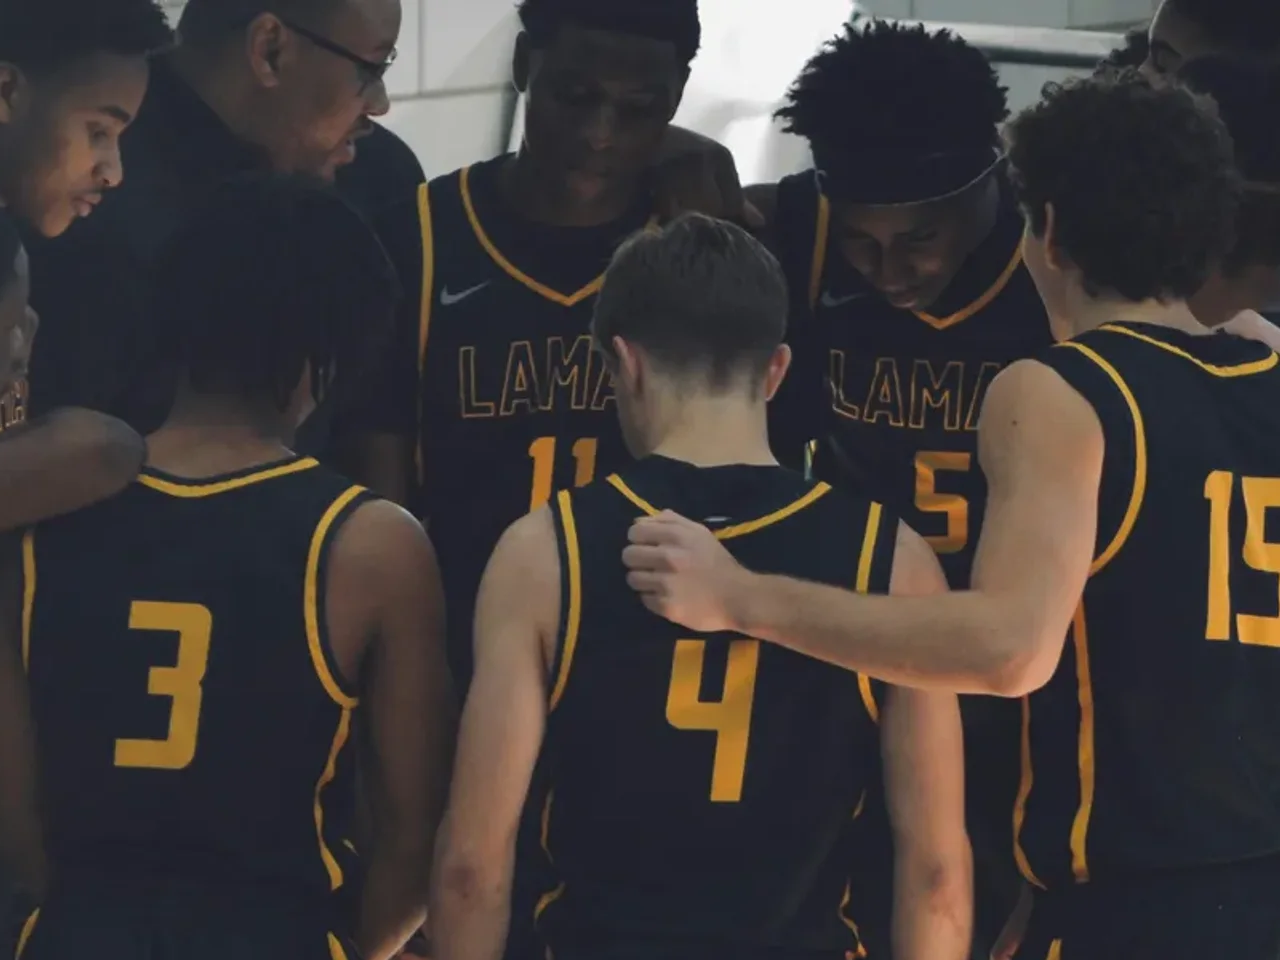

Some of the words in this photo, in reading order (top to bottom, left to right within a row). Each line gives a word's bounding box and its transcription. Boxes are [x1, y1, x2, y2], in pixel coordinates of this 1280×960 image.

[527, 436, 598, 512] 11
[914, 450, 971, 554] 5
[113, 600, 213, 770] 3
[664, 639, 760, 803] 4
